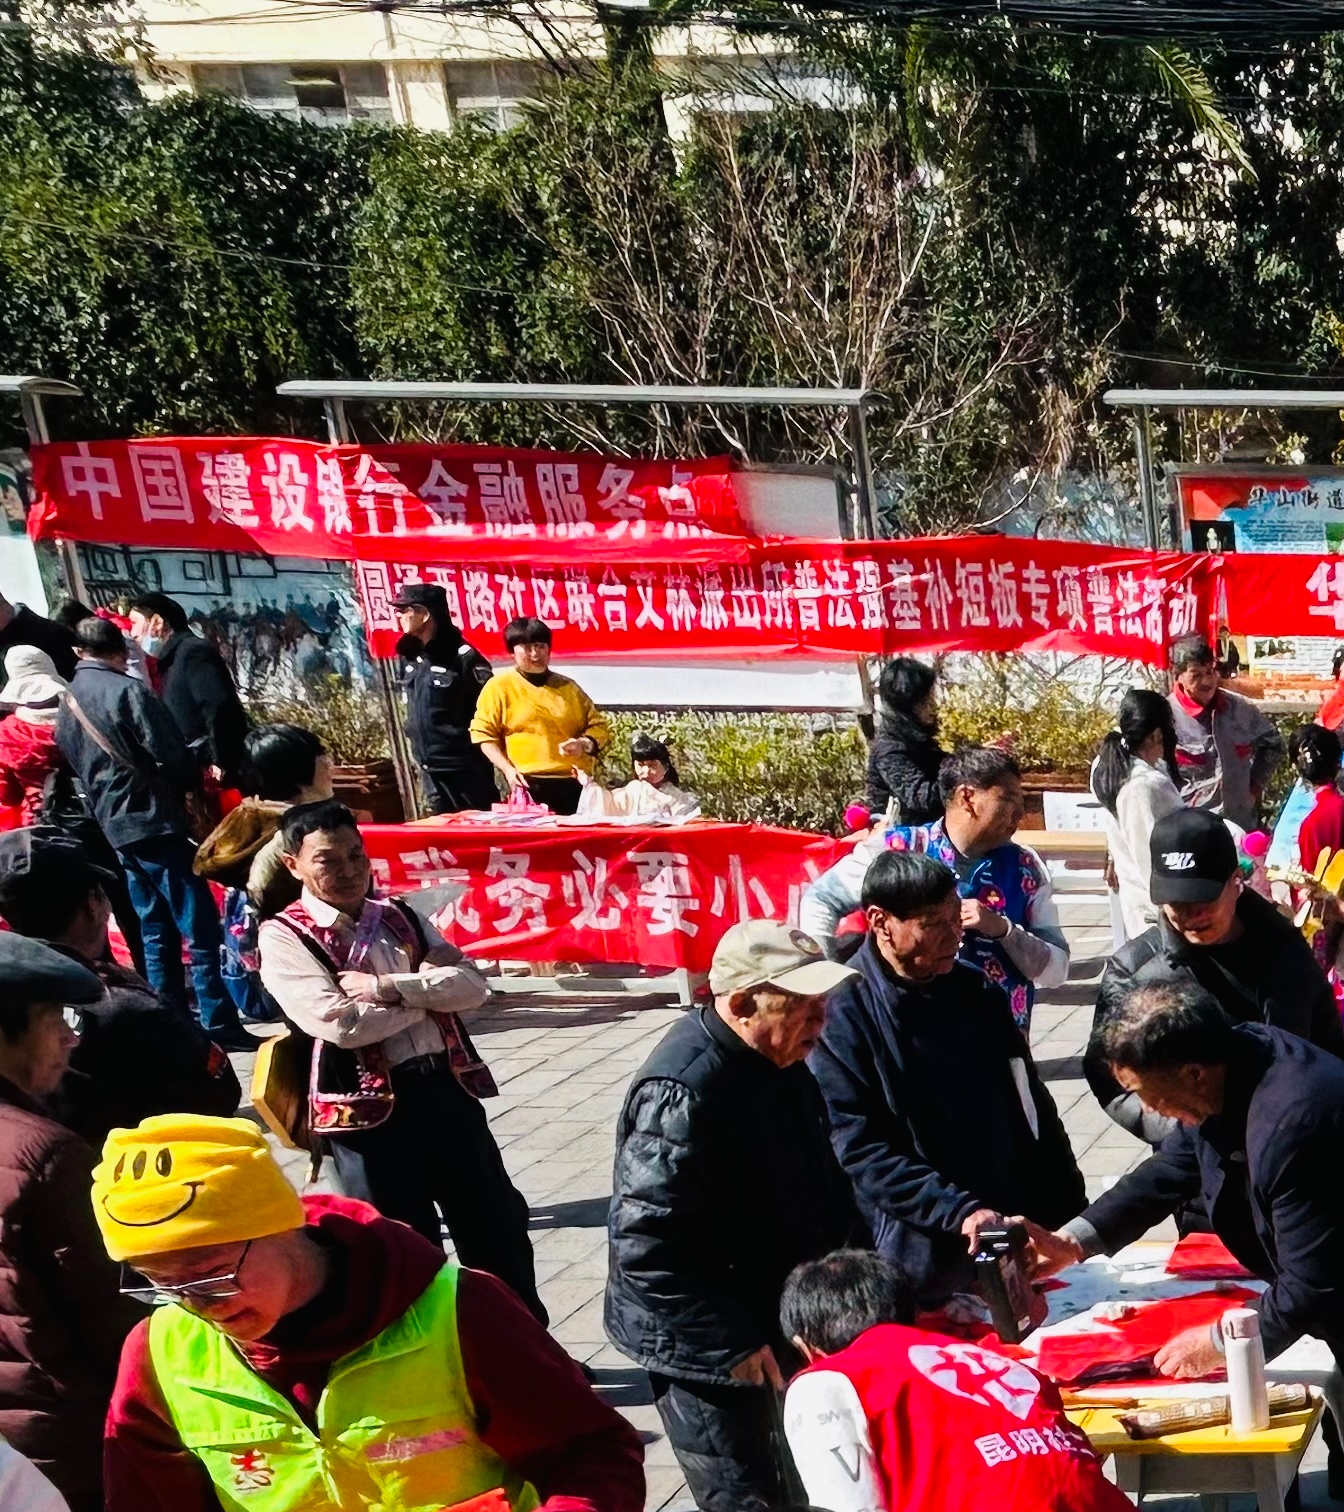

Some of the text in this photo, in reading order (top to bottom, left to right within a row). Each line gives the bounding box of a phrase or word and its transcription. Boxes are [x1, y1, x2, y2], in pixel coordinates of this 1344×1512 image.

[60, 441, 714, 540] 中国建设银行金融服务点
